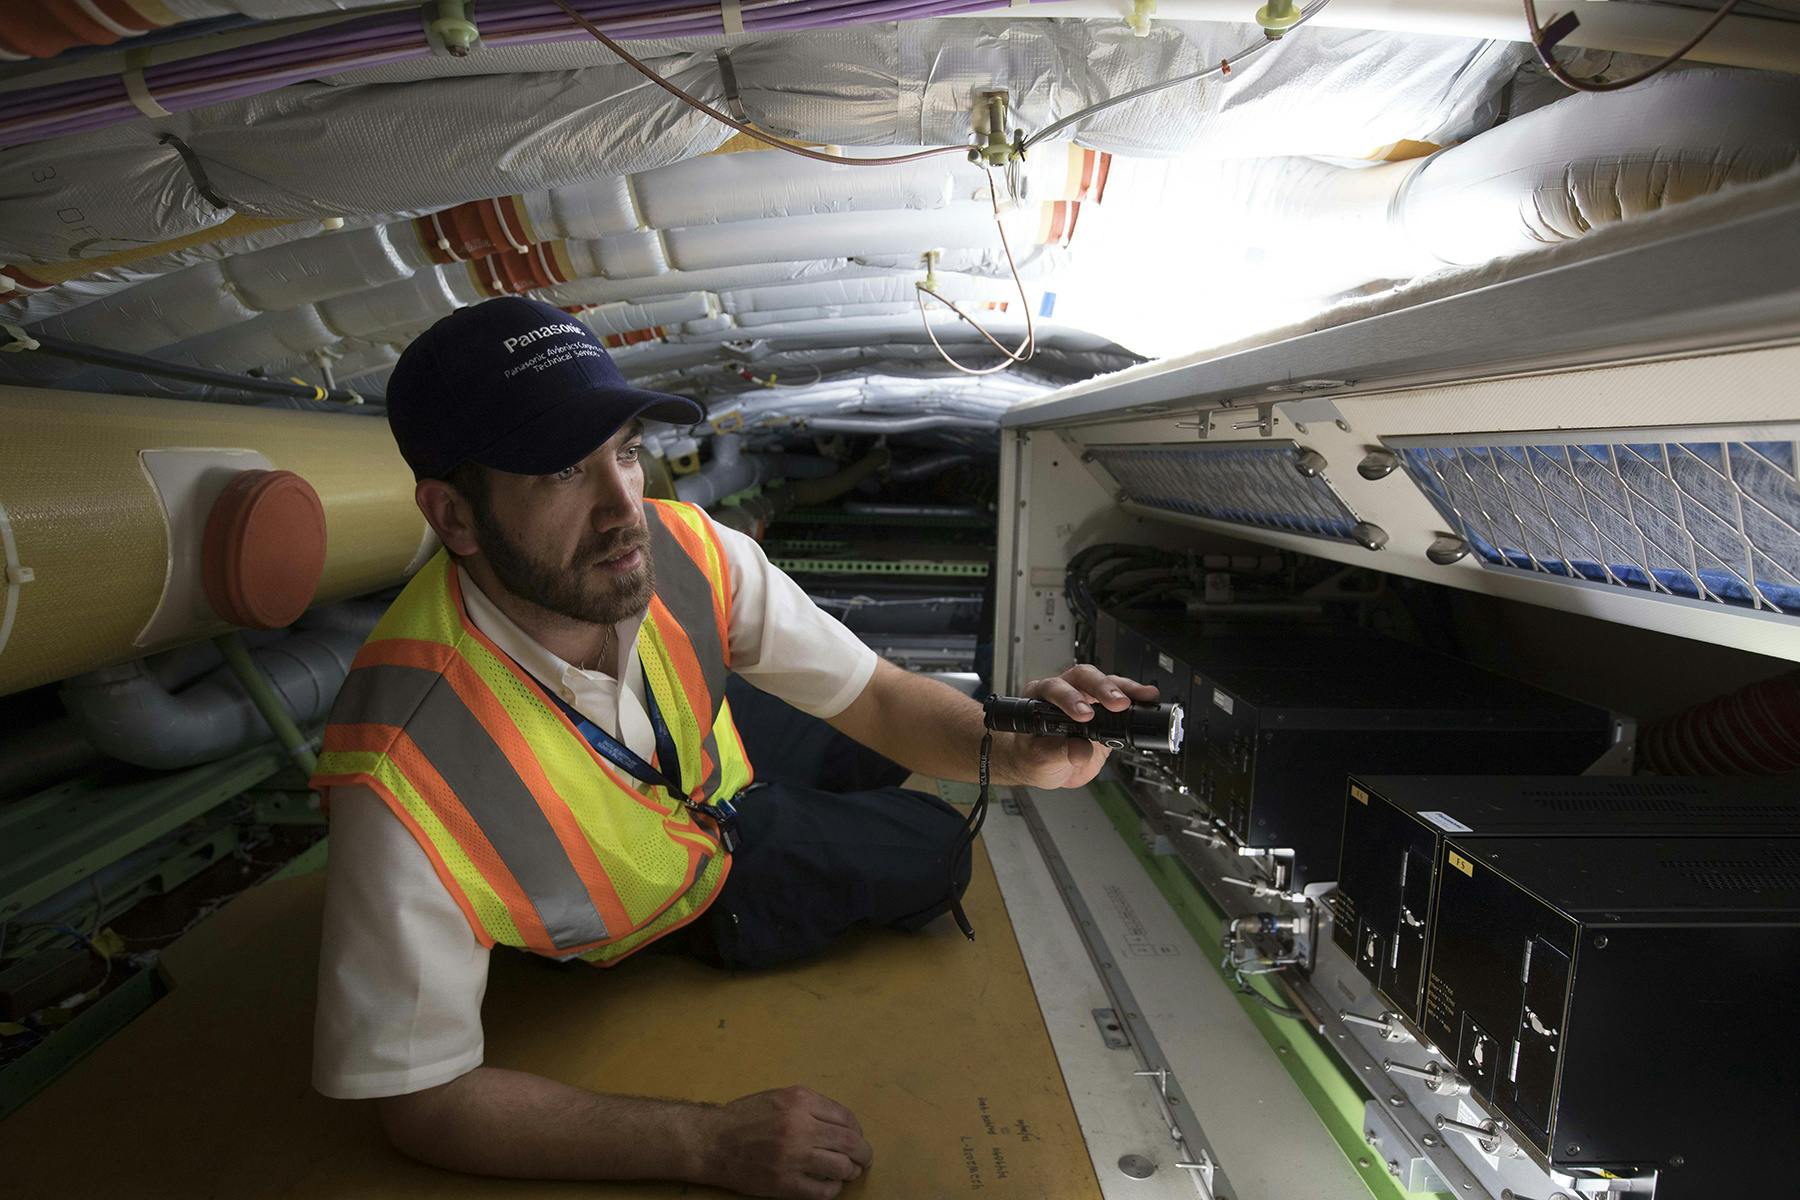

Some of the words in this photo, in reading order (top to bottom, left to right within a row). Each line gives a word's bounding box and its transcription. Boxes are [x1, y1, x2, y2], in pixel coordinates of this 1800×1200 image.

[503, 323, 585, 353] Panasonic
[504, 353, 547, 379] Panasonic
[533, 352, 572, 372] Technical
